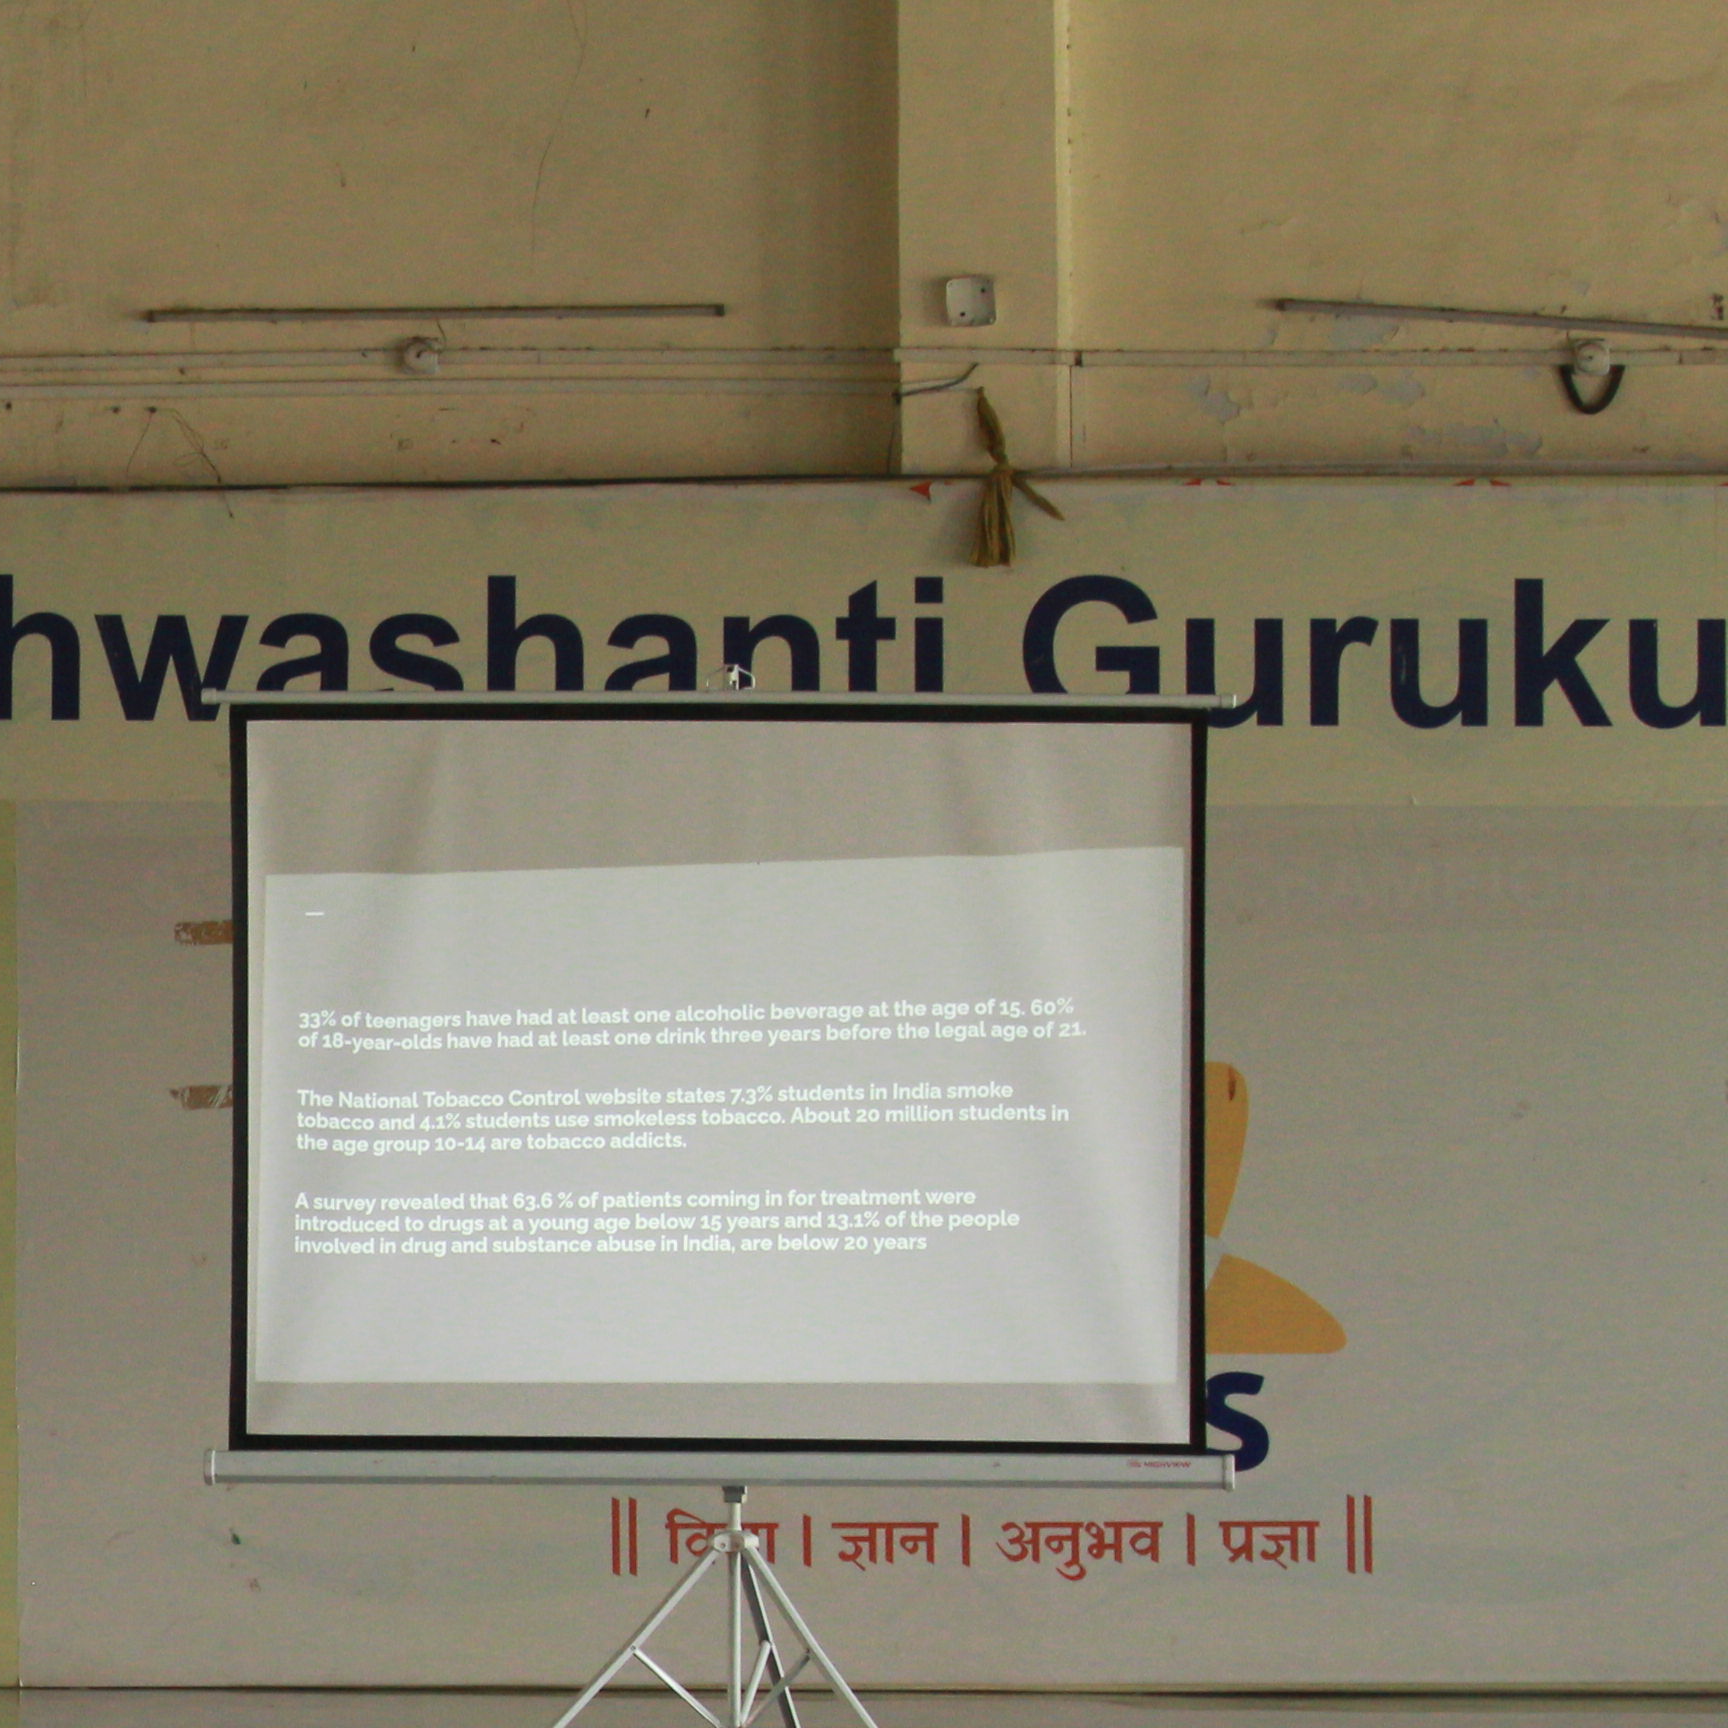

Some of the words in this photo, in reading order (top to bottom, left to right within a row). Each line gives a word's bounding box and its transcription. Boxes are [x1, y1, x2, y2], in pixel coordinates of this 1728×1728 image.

[299, 1010, 337, 1029] 33%
[341, 1011, 362, 1027] of
[365, 1013, 461, 1032] teenagers
[466, 1010, 512, 1027] have
[516, 1008, 553, 1025] had
[557, 1008, 577, 1025] at
[582, 1007, 630, 1024] least
[634, 1010, 671, 1023] one
[675, 1004, 765, 1022] alcoholic
[770, 1003, 864, 1023] beverage
[868, 1001, 889, 1017] at
[893, 1000, 927, 1017] the
[931, 1003, 970, 1020] age
[974, 998, 996, 1015] of
[999, 1001, 1025, 1018] 15.
[1031, 997, 1074, 1015] 60%
[298, 1031, 319, 1048] of
[322, 1032, 442, 1054] 18-year-olds
[447, 1032, 492, 1049] have
[497, 1030, 533, 1048] had
[538, 1031, 558, 1047] at
[562, 1029, 610, 1047] least
[614, 1032, 652, 1045] one
[656, 1027, 706, 1044] drink
[710, 1026, 763, 1043] three
[767, 1029, 821, 1047] years
[826, 1023, 892, 1041] before
[897, 1022, 930, 1039] the
[935, 1020, 987, 1042] legal
[991, 1025, 1028, 1042] age
[1033, 1021, 1055, 1038] of
[1059, 1021, 1086, 1037] 21.
[297, 1089, 334, 1107] The
[339, 1091, 419, 1109] National
[422, 1090, 504, 1108] Tobacco
[508, 1088, 581, 1106] Control
[585, 1087, 662, 1105] website
[666, 1087, 726, 1103] states
[730, 1085, 773, 1105] 7.3%
[778, 1084, 865, 1102] students
[870, 1083, 887, 1100] in
[893, 1082, 942, 1099] India
[947, 1081, 1014, 1099] smoke
[297, 1112, 374, 1130] tobacco
[379, 1113, 415, 1130] and
[420, 1113, 461, 1131] 4.1%
[466, 1112, 550, 1128] students
[555, 1115, 589, 1127] use
[594, 1109, 696, 1127] smokeless
[701, 1108, 786, 1125] tobacco.
[790, 1106, 851, 1124] About
[856, 1108, 880, 1123] 20
[885, 1105, 954, 1122] million
[959, 1103, 1046, 1121] students
[1051, 1104, 1069, 1121] in
[296, 1133, 328, 1150] the
[332, 1139, 369, 1156] age
[373, 1139, 430, 1156] group
[435, 1136, 486, 1153] 10-14
[490, 1138, 522, 1150] are
[527, 1133, 606, 1150] tobacco
[610, 1131, 687, 1149] addicts.
[295, 1192, 309, 1209] A
[313, 1197, 377, 1215] survey
[381, 1193, 465, 1210] revealed
[469, 1193, 509, 1209] that
[513, 1192, 553, 1211] 63.6
[557, 1192, 574, 1208] %
[578, 1191, 599, 1208] of
[603, 1191, 682, 1212] patients
[687, 1190, 760, 1211] coming
[765, 1189, 783, 1206] in
[787, 1189, 816, 1206] for
[820, 1189, 921, 1205] treatment
[925, 1191, 976, 1204] were
[295, 1214, 399, 1232] introduced
[405, 1216, 424, 1231] to
[429, 1215, 484, 1235] drugs
[489, 1215, 507, 1231] at
[513, 1219, 524, 1230] a
[529, 1218, 588, 1235] young
[593, 1218, 631, 1235] age
[636, 1213, 696, 1229] below
[701, 1215, 721, 1232] 15
[727, 1216, 779, 1233] years
[785, 1211, 822, 1228] and
[828, 1211, 880, 1231] 13.1%
[885, 1210, 906, 1227] of
[910, 1210, 944, 1227] the
[948, 1209, 1020, 1231] people
[295, 1236, 375, 1254] involved
[380, 1237, 396, 1254] in
[401, 1237, 447, 1258] drug
[451, 1236, 488, 1253] and
[492, 1236, 592, 1253] substance
[597, 1235, 656, 1252] abuse
[661, 1235, 678, 1251] in
[683, 1234, 735, 1253] India,
[740, 1238, 773, 1251] are
[778, 1233, 839, 1251] below
[844, 1236, 868, 1250] 20
[873, 1237, 927, 1255] years
[831, 1522, 939, 1571] ज्ञान
[995, 1520, 1164, 1582] अनुभव
[1219, 1520, 1320, 1570] प्रज्ञा
